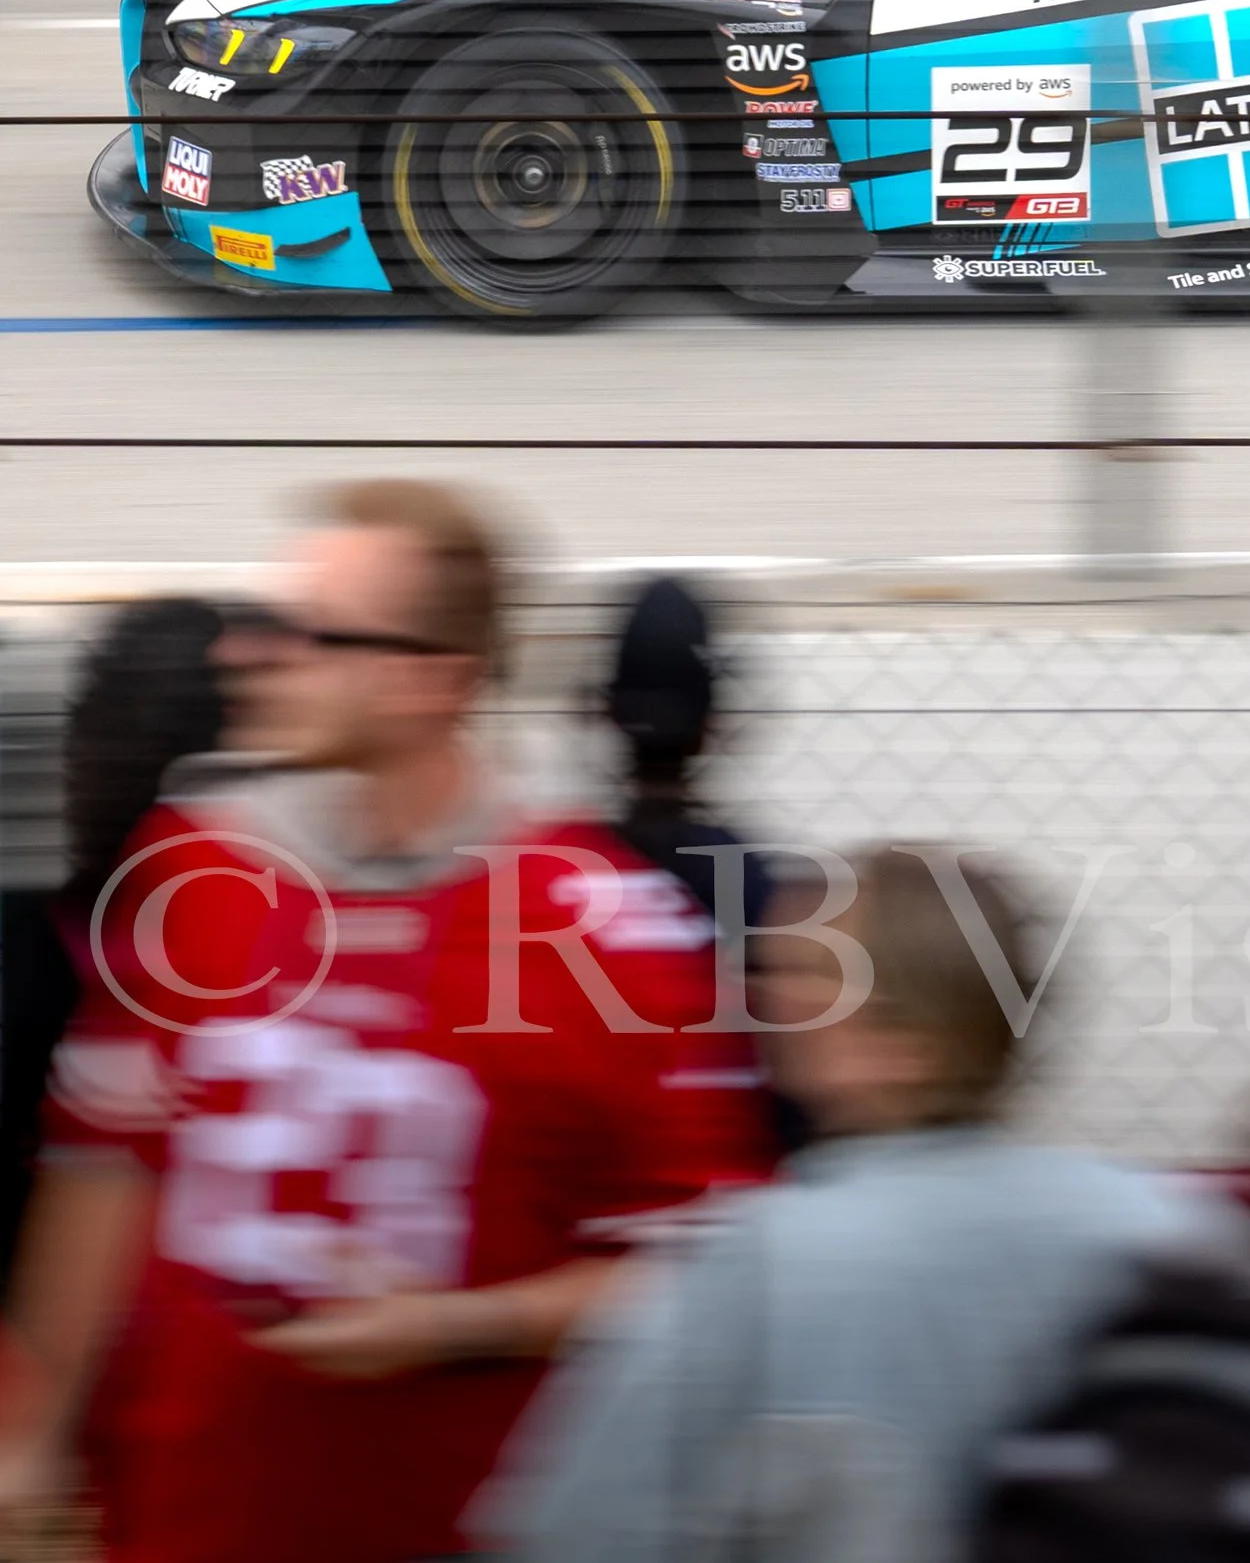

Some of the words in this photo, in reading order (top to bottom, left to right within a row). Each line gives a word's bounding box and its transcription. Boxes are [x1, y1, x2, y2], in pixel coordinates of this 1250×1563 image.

[726, 43, 806, 72] aws
[168, 67, 236, 102] TURNER
[951, 79, 1012, 94] powered
[1016, 79, 1033, 93] by
[1039, 78, 1071, 89] aws
[170, 140, 210, 176] LIQUI
[763, 138, 829, 156] OPTIMA
[940, 117, 1087, 183] 29
[165, 166, 209, 204] MOLY
[278, 161, 345, 204] KW
[1026, 198, 1080, 214] GT3
[216, 235, 268, 261] PIRELLI
[1168, 274, 1205, 289] Tile
[1207, 264, 1244, 284] and
